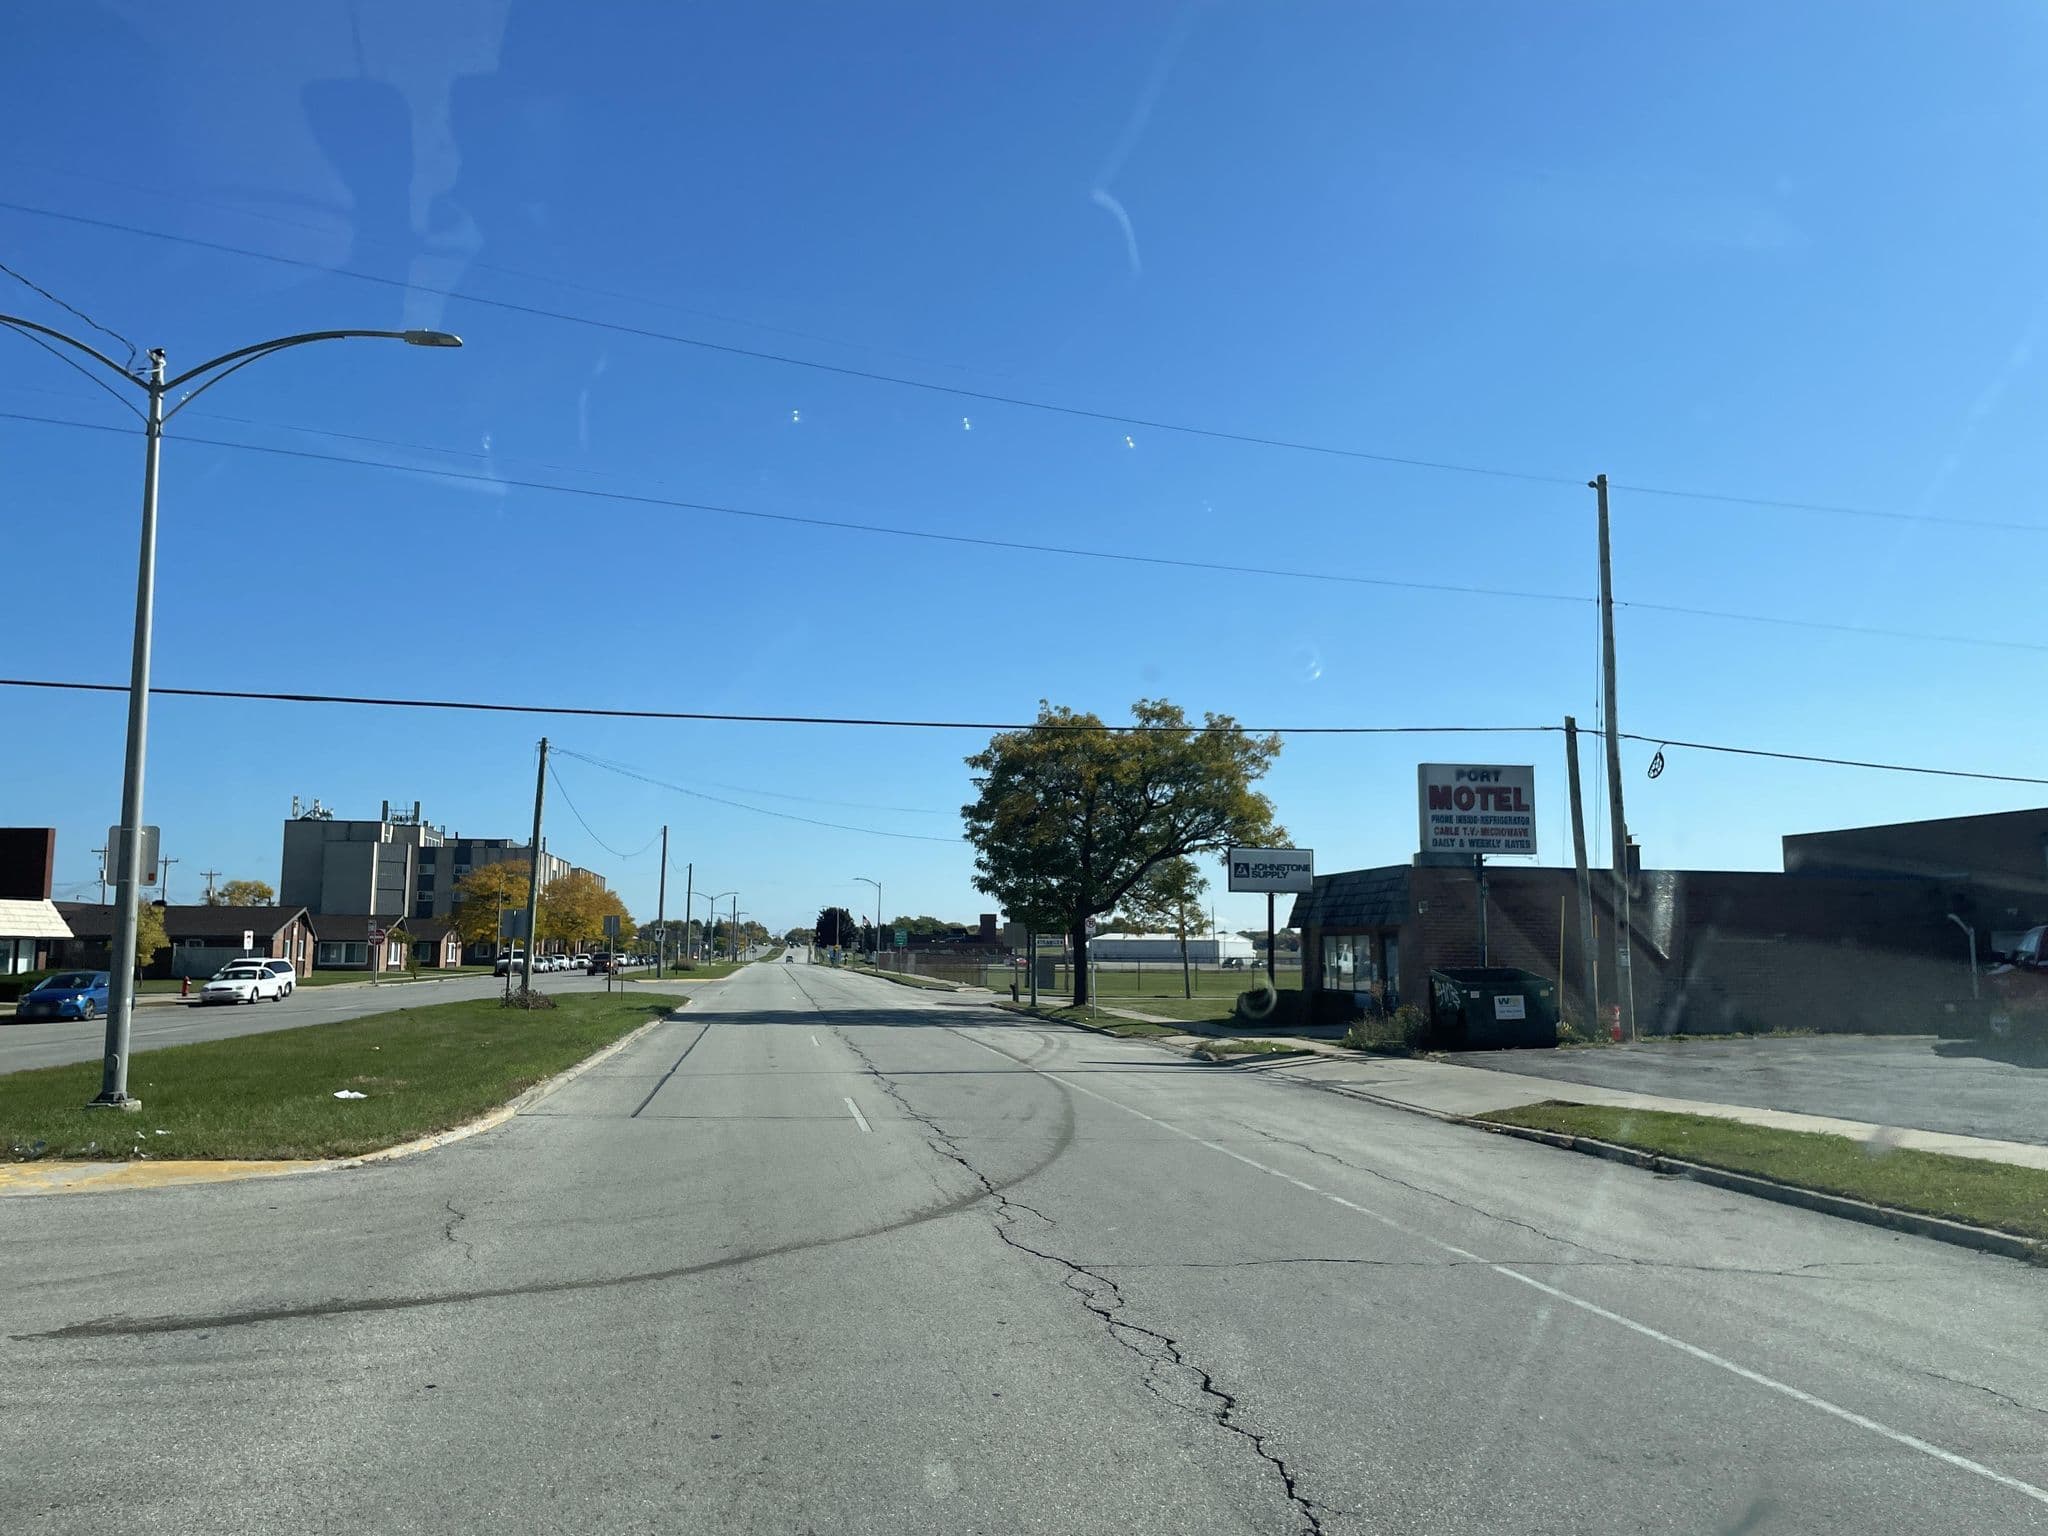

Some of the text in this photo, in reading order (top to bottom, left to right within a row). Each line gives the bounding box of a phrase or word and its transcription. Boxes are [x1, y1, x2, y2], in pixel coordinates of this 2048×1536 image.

[1456, 770, 1501, 782] PORT
[1428, 785, 1530, 812] MOTEL
[1434, 826, 1459, 836] CABLE
[1432, 838, 1456, 848] DAILY
[1468, 839, 1501, 849] WEEKLY
[1251, 863, 1310, 872] JOHNSTONE
[1251, 871, 1288, 879] SUPPLY
